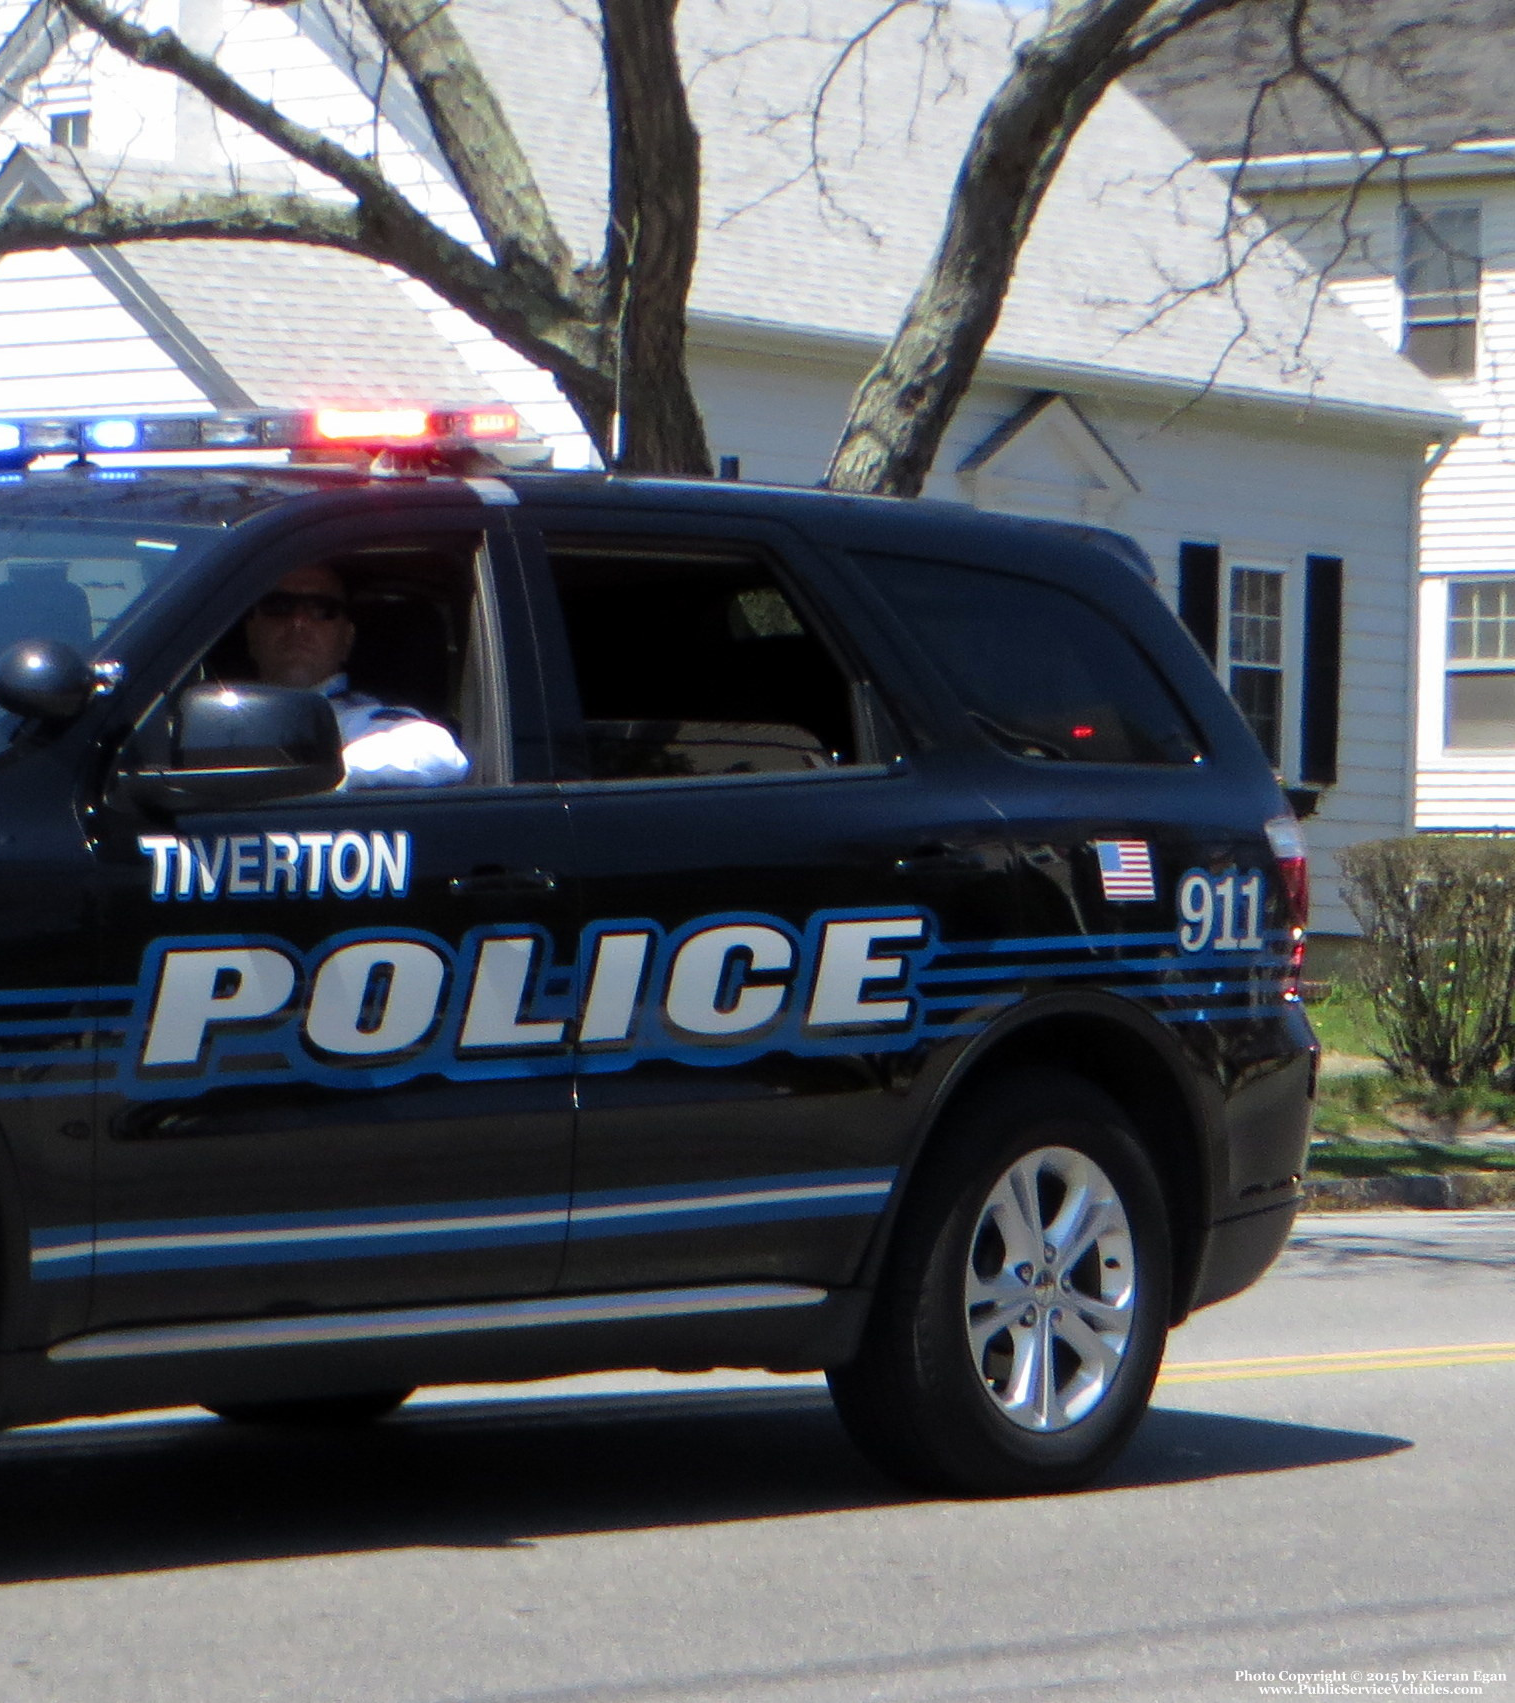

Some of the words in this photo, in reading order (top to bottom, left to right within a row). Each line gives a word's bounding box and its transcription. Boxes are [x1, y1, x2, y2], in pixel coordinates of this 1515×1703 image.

[139, 832, 410, 897] TIVERTON
[1178, 873, 1265, 954] 911
[139, 914, 925, 1068] POLICE
